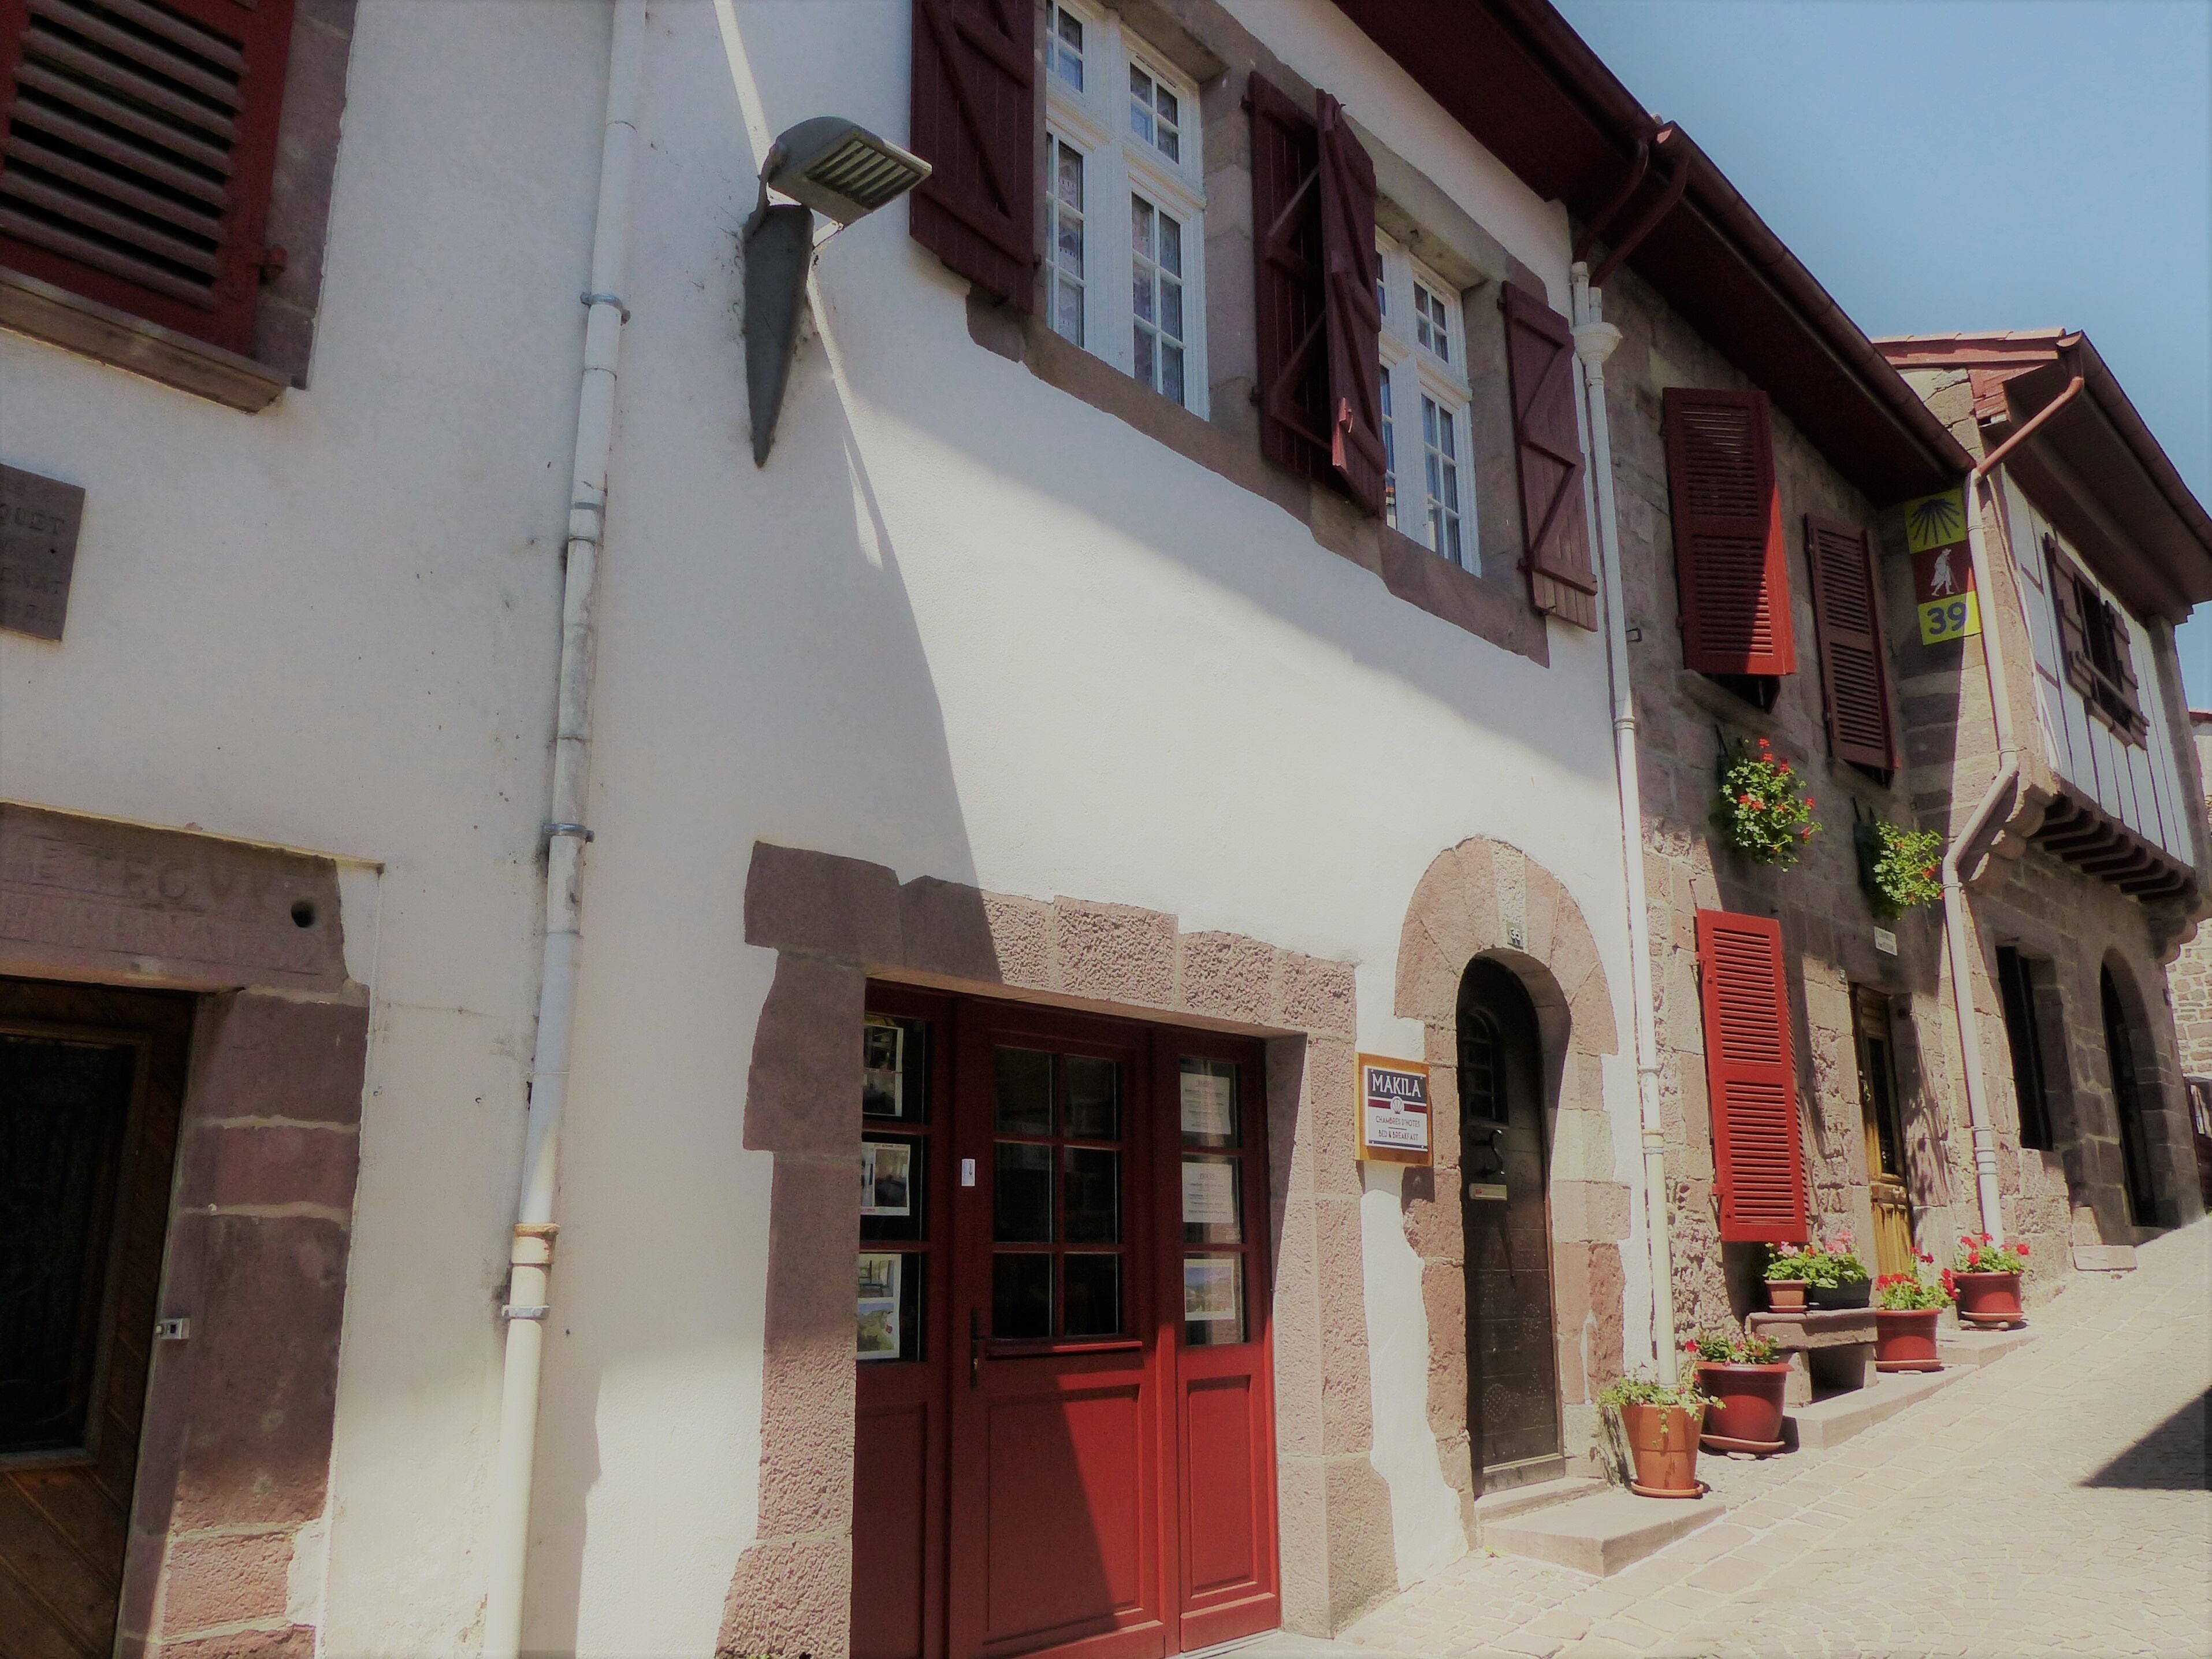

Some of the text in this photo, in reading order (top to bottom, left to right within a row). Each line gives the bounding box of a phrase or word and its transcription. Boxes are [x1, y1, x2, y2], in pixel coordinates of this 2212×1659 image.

[1927, 602, 1966, 634] 39
[1372, 1073, 1421, 1097] MAKILA
[1375, 1115, 1400, 1125] CHAMBRES
[1392, 1131, 1419, 1141] BREAKFAST
